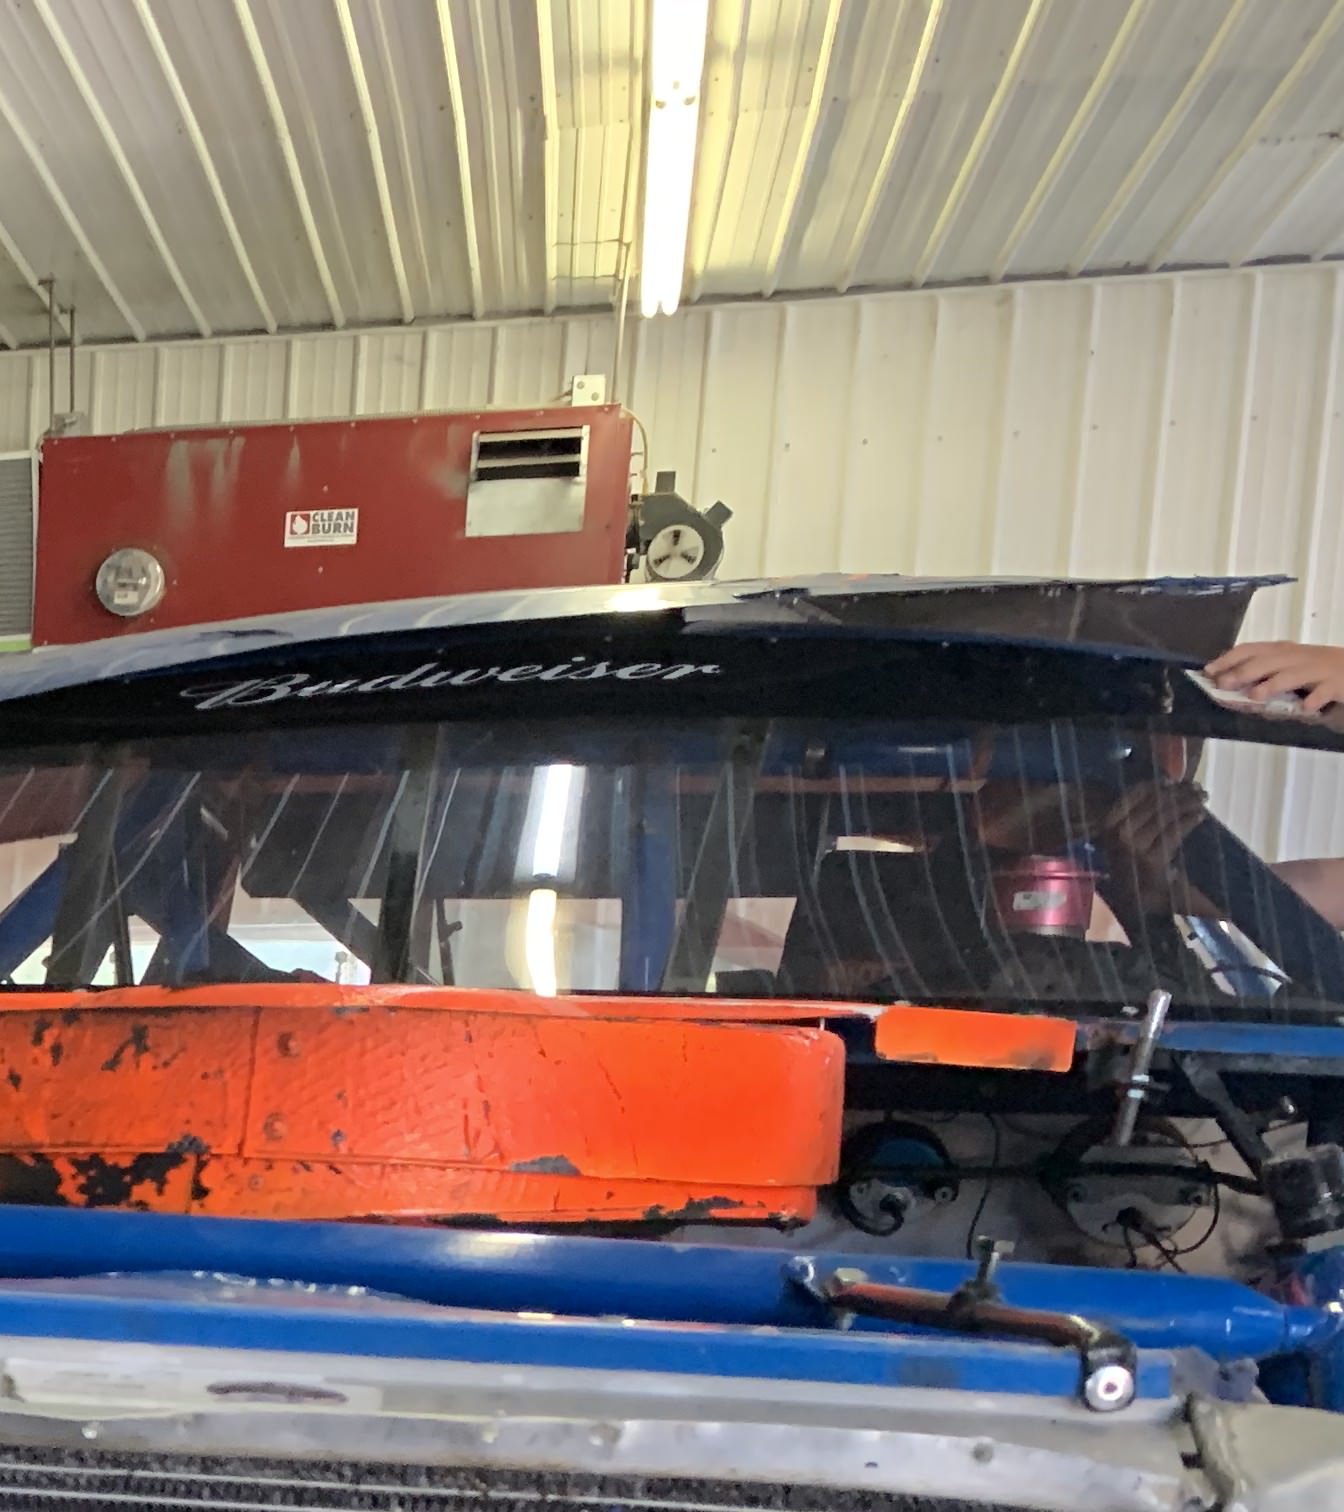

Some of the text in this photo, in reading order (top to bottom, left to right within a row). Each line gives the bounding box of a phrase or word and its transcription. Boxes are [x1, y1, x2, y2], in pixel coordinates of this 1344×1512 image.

[312, 511, 355, 523] CLEAN
[311, 522, 354, 535] BURN
[180, 656, 723, 711] Budweiser
